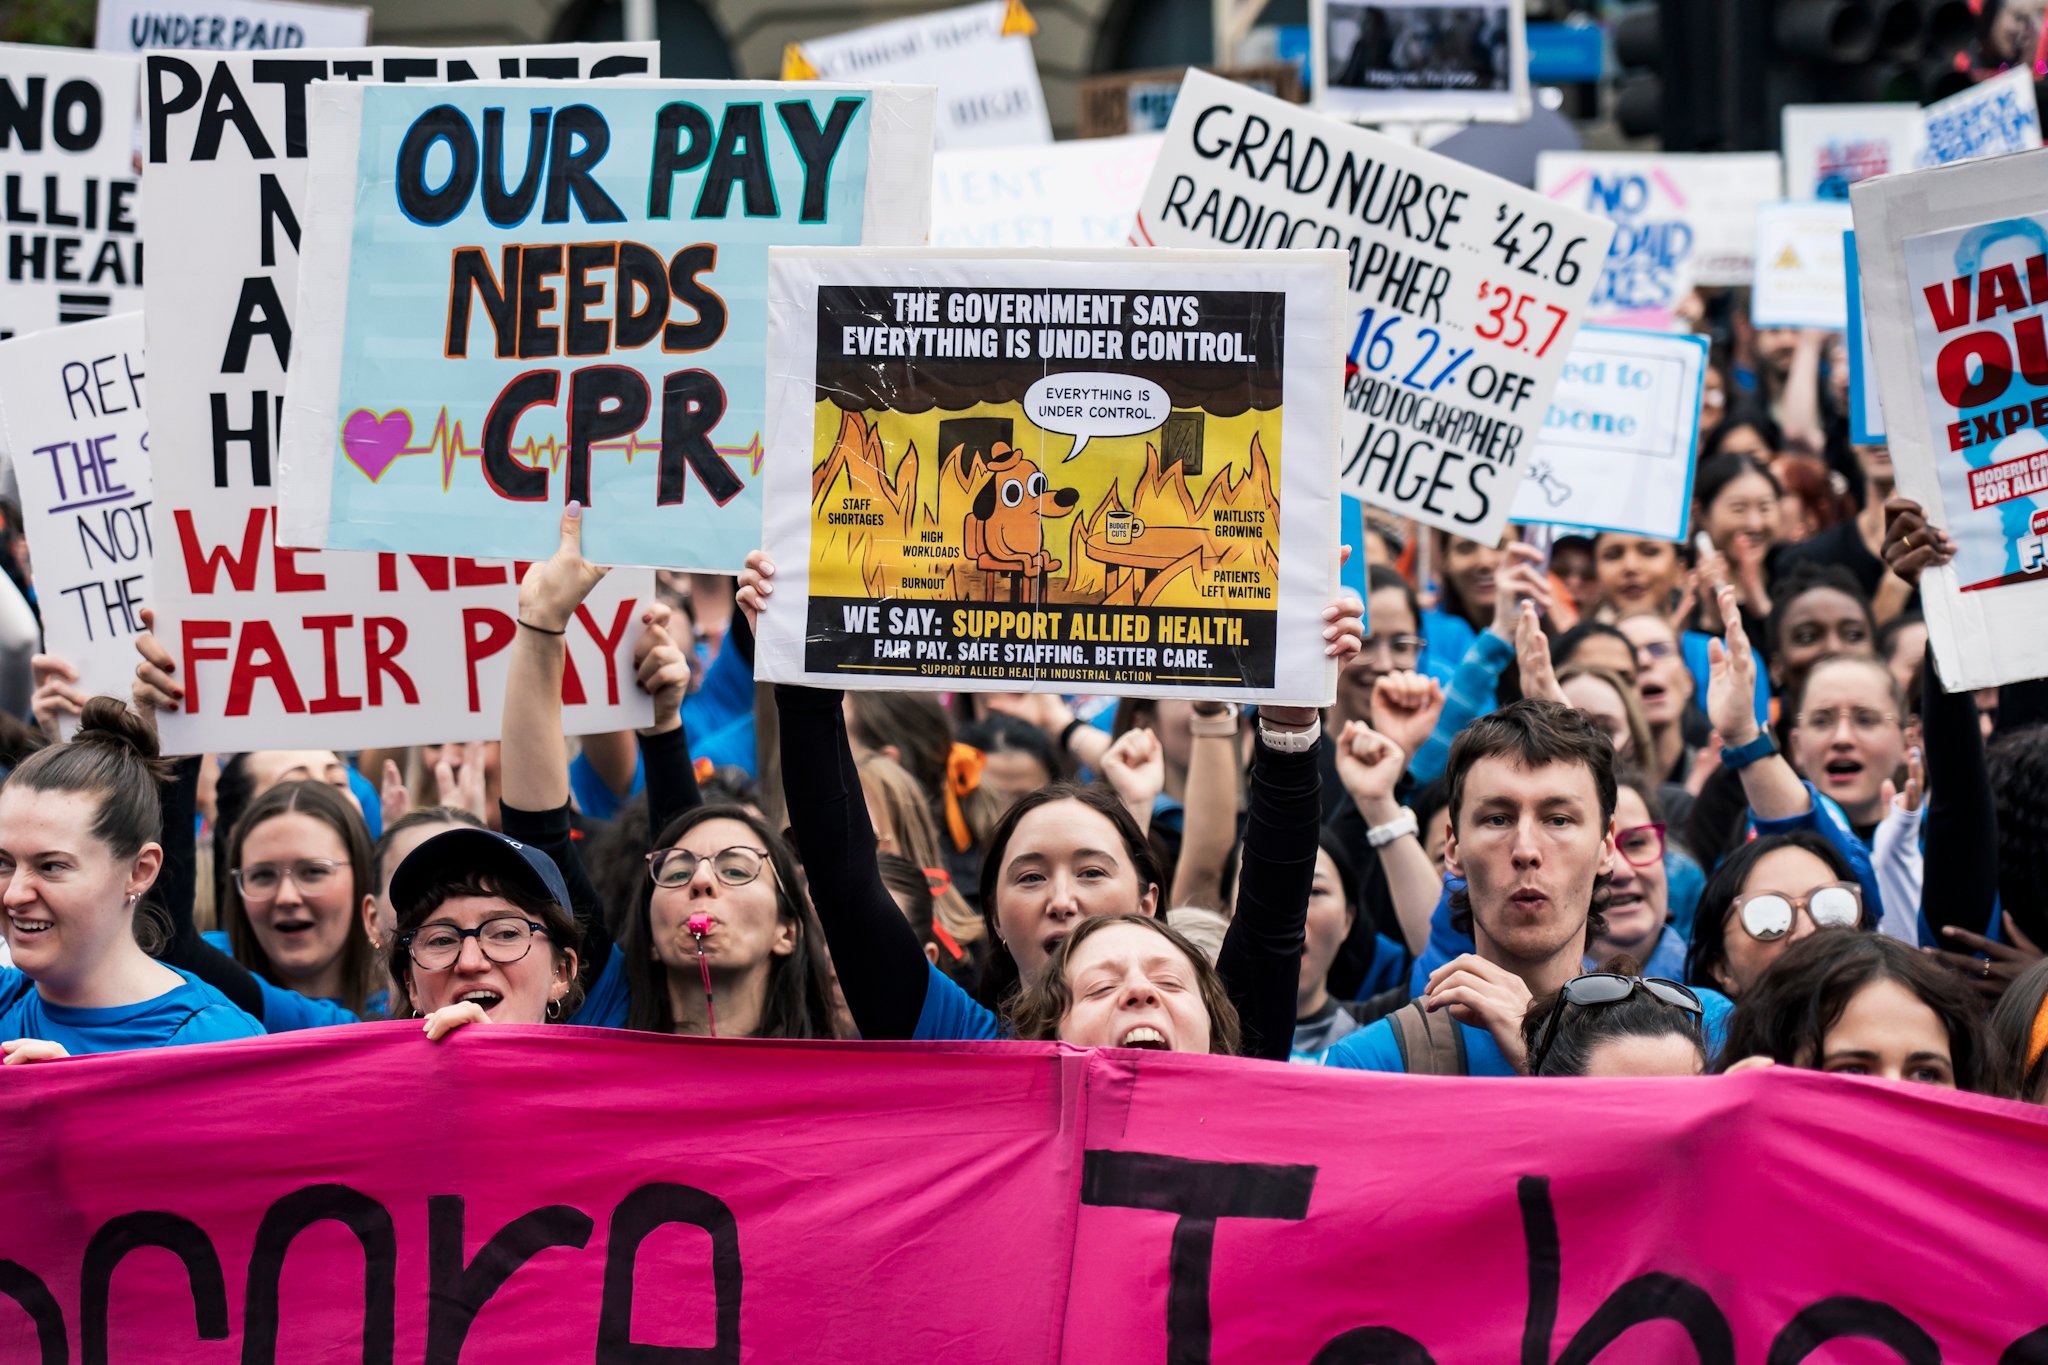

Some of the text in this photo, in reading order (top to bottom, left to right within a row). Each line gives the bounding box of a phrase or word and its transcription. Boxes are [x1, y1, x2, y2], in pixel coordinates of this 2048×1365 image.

[395, 103, 628, 230] OUR
[646, 97, 866, 225] PAY
[1192, 104, 1330, 194] GRAD
[1492, 202, 1588, 286] $42.6
[1586, 174, 1649, 215] NO
[444, 240, 728, 360] NEEDS
[893, 292, 1199, 327] THE GOVERNMENT SAYS
[1474, 280, 1569, 359] $35.7
[842, 325, 1256, 363] EVERYTHING IS UNDER CONTROL.
[1347, 307, 1535, 412] 16.2% OFF
[1046, 387, 1150, 401] EVERYTHING IS
[1038, 405, 1156, 419] UNDER CONTROL.
[1344, 373, 1523, 467] RADIOGRAPHER
[480, 364, 745, 508] CPR
[32, 434, 127, 501] THE
[1972, 458, 2029, 486] MODERN
[1975, 468, 2048, 507] FOR ALLI
[842, 498, 871, 511] STAFF
[1213, 509, 1265, 523] WAITLISTS
[828, 513, 884, 526] SHORTAGES
[1109, 522, 1130, 530] BUDGET
[1111, 530, 1127, 538] CUTS
[1215, 525, 1263, 538] GROWING
[902, 545, 960, 558] WORKLOADS
[920, 531, 943, 543] HIGH
[901, 577, 945, 590] BURNOUT
[1213, 570, 1260, 583] PATIENTS
[1201, 585, 1271, 599] LEFT WAITING
[842, 605, 1250, 646] WE SAY: SUPPORT ALLIED HEALTH.
[181, 613, 420, 716] FAIR
[874, 639, 1214, 669] FAIR PAY. SAFE STAFFING. BETTER CARE.
[921, 663, 1152, 682] SUPPORT ALLIED HEALTH INDUSTRIAL ACTION
